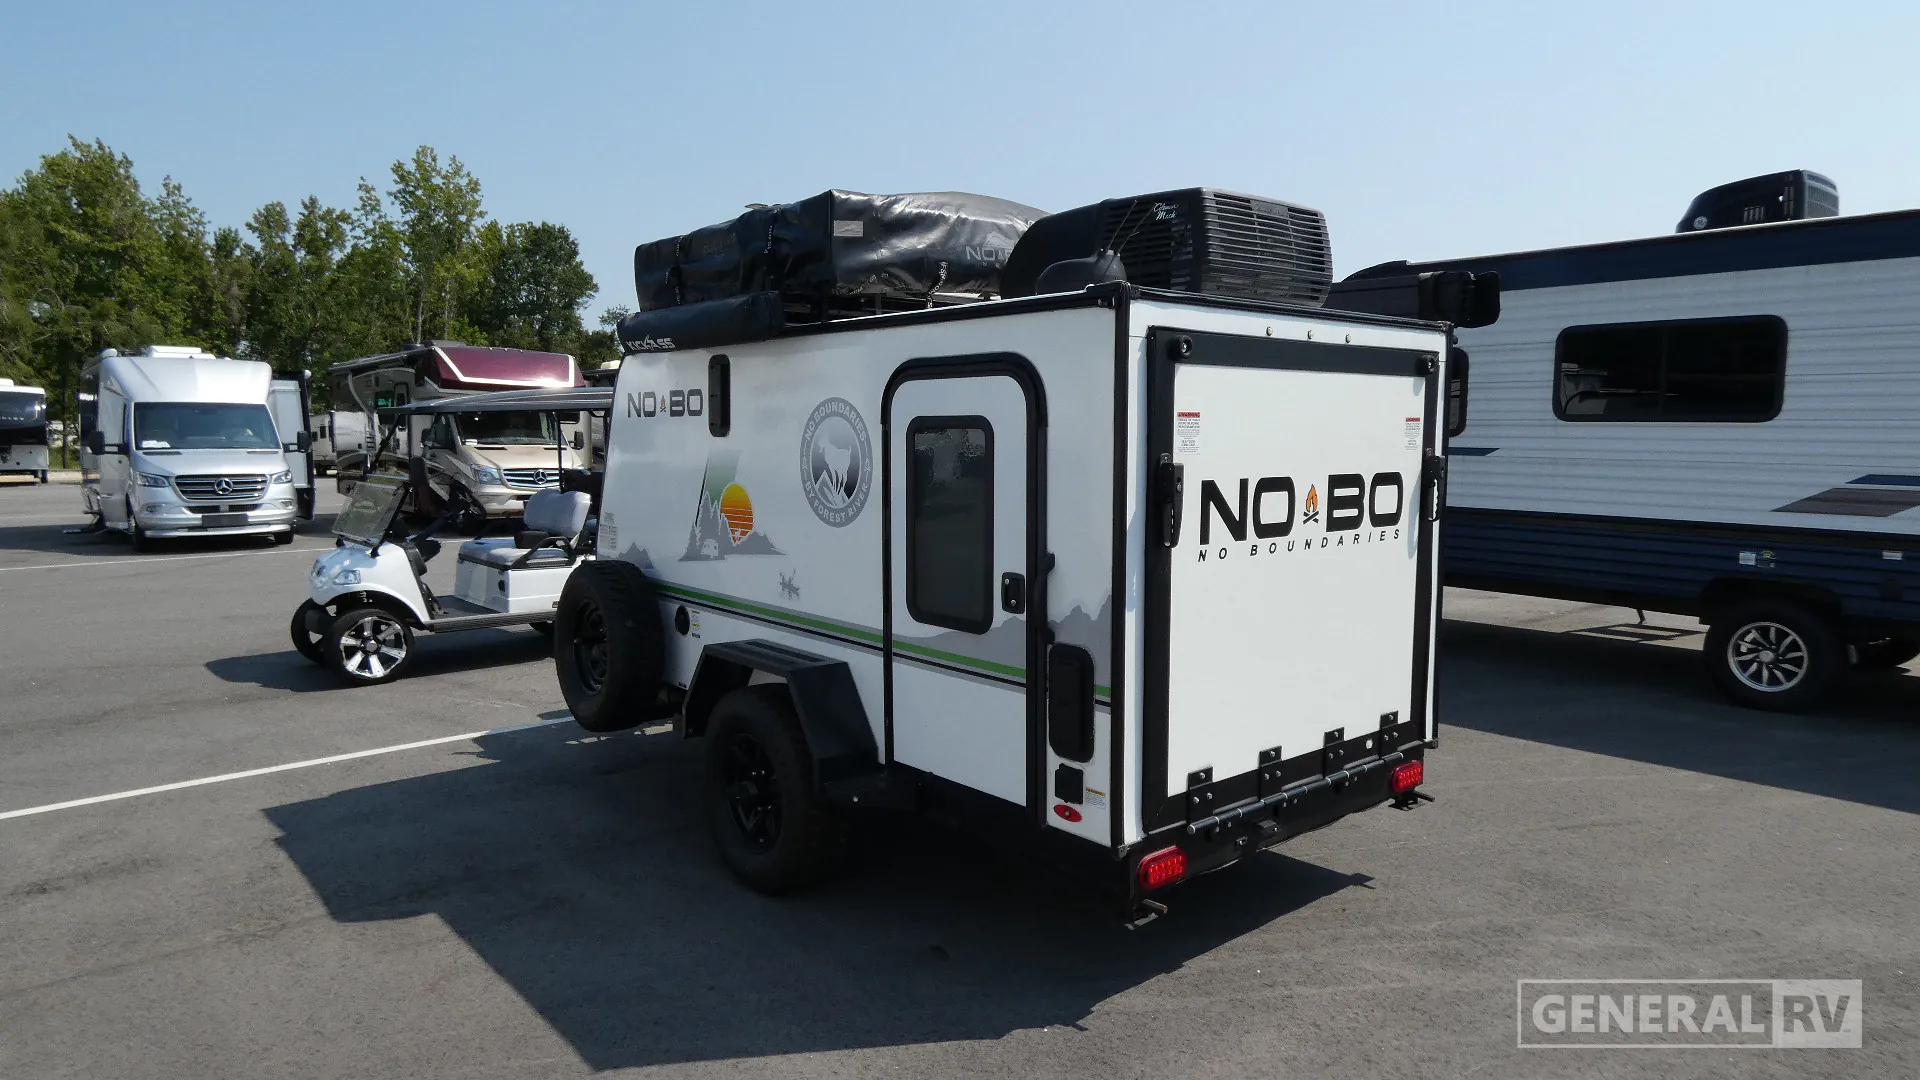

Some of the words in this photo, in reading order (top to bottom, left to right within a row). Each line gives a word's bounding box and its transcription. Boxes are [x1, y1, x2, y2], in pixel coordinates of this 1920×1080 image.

[627, 391, 656, 418] NO
[669, 389, 704, 418] BO
[805, 421, 816, 441] NO
[814, 401, 868, 441] BOUNDARIES
[804, 481, 815, 498] BY
[814, 499, 846, 523] FOREST
[847, 483, 869, 517] RIVER
[1199, 476, 1296, 545] NO
[1326, 472, 1404, 532] BO
[1198, 547, 1228, 562] NO
[1250, 528, 1400, 557] BOUNDARIES
